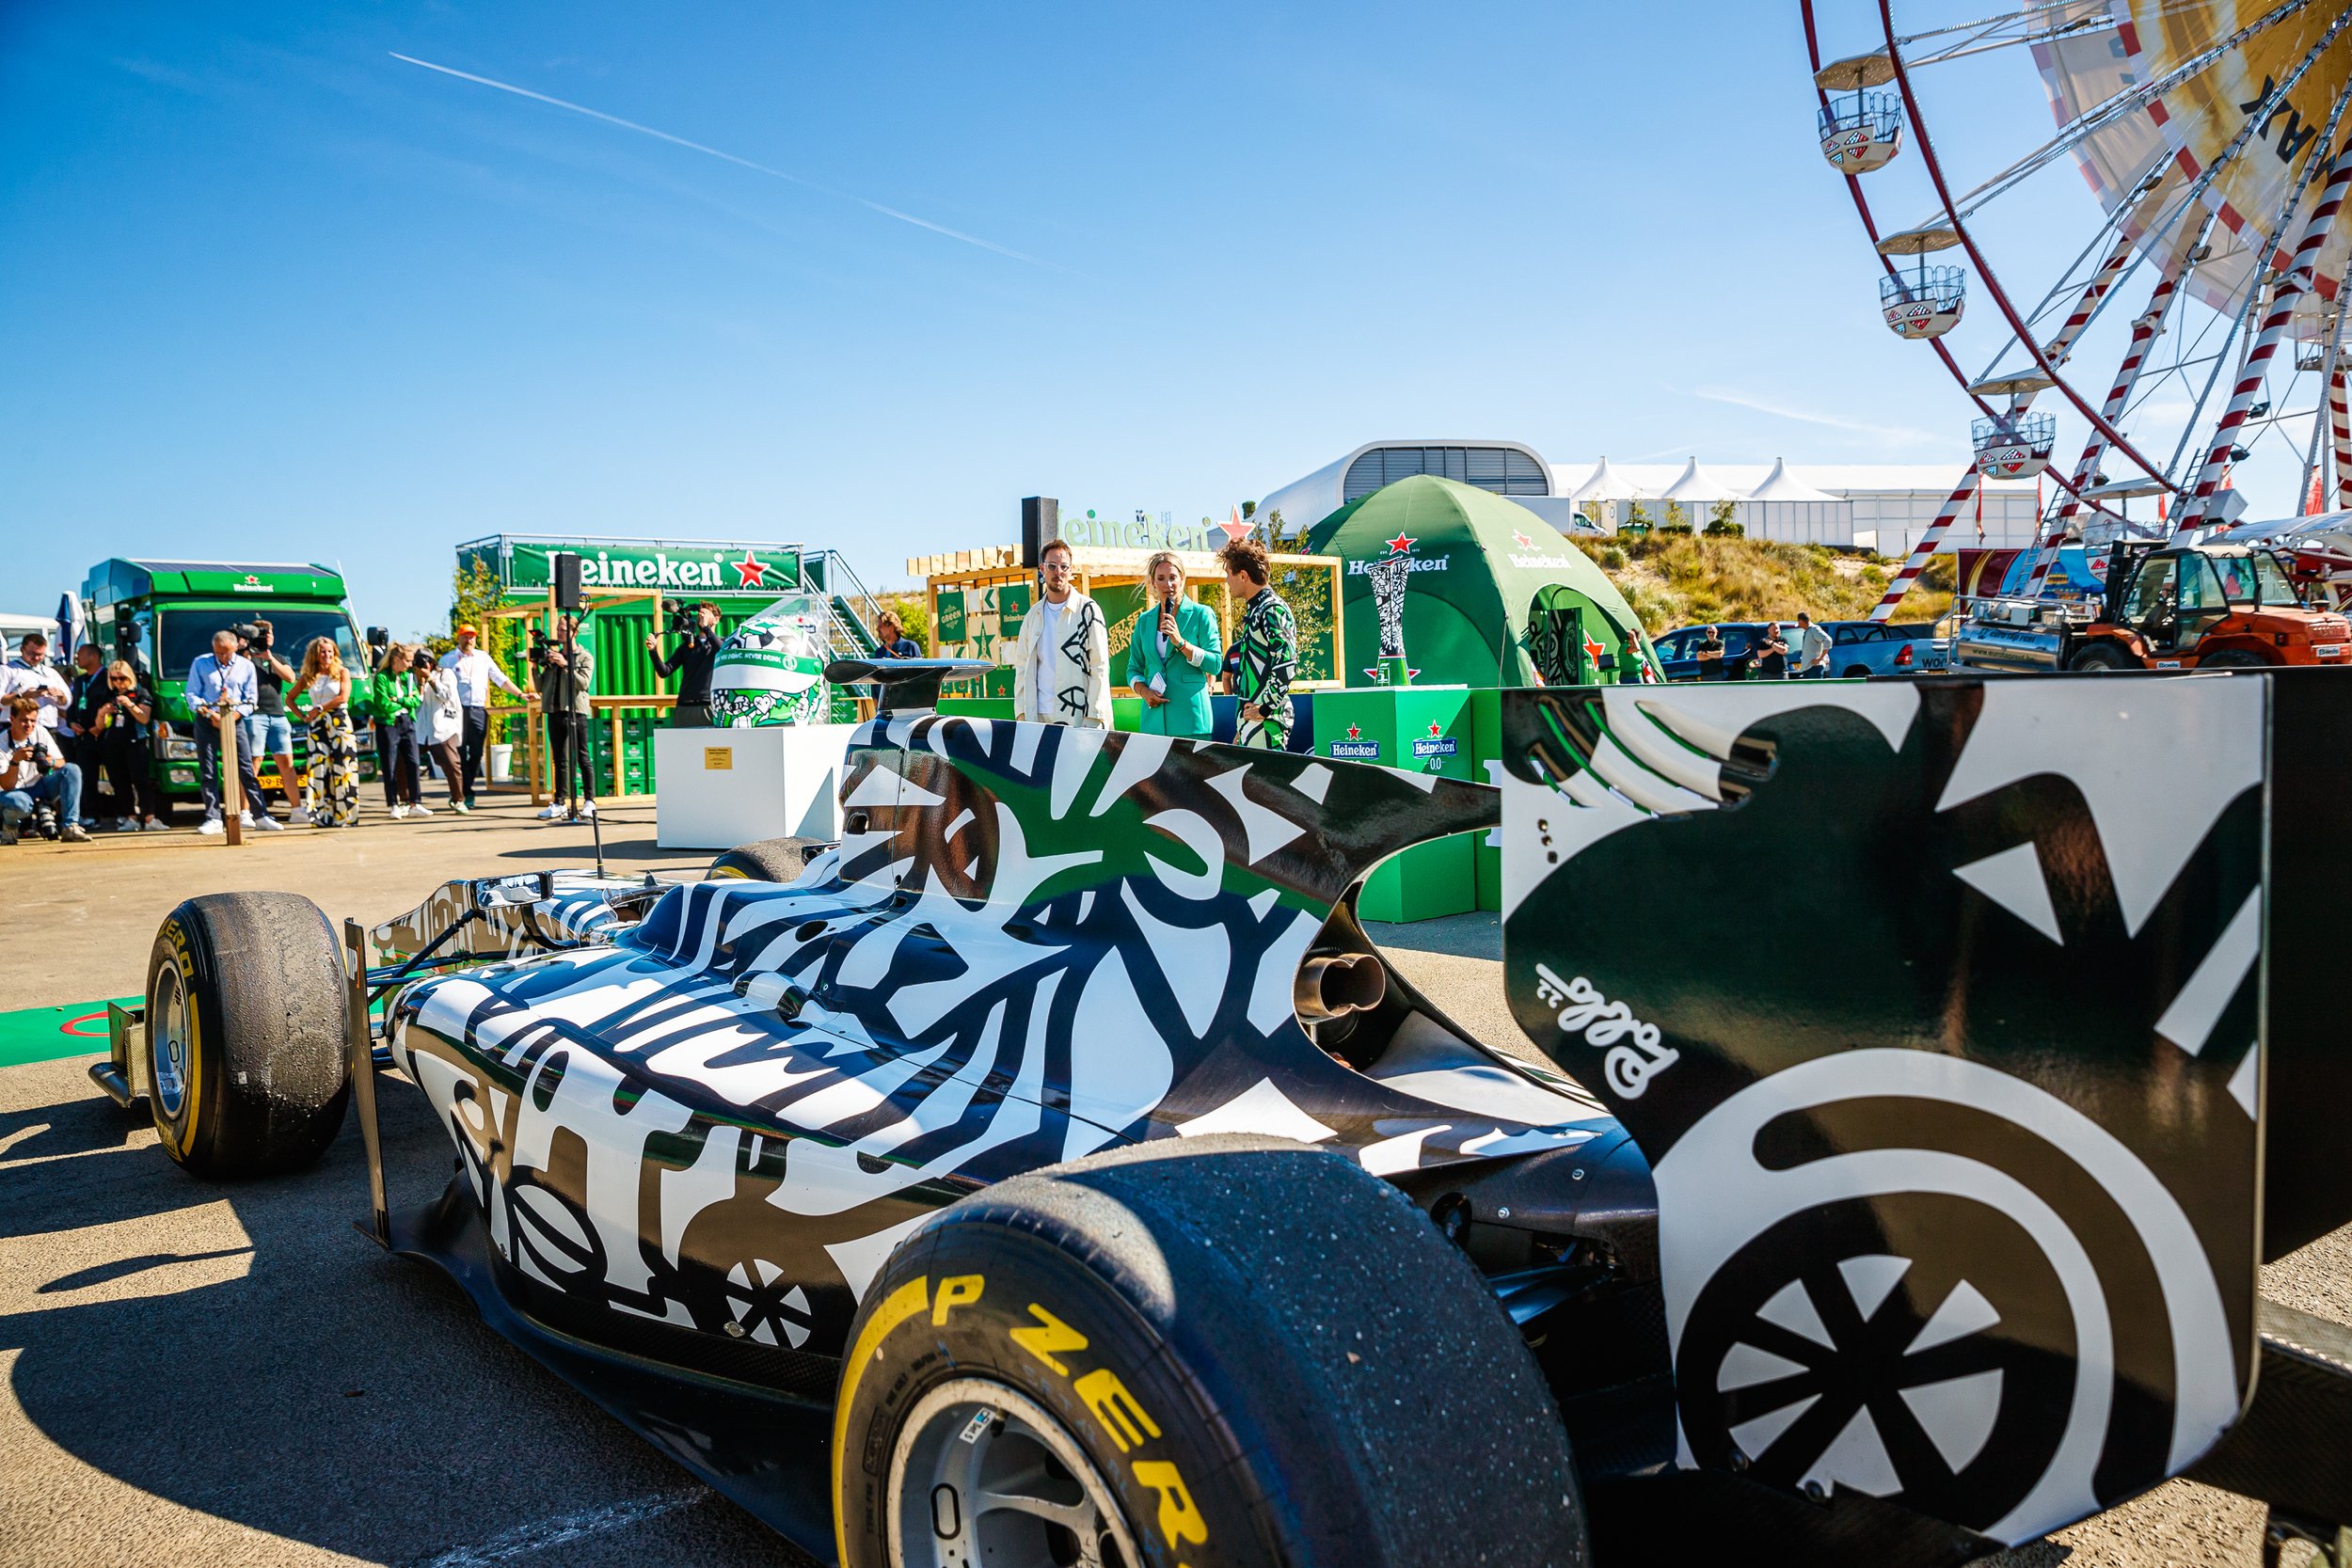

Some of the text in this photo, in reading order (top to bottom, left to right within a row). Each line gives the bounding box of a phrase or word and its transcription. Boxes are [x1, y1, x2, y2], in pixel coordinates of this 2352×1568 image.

[1507, 553, 1572, 569] Heineken
[1332, 744, 1377, 756] Heineken
[1415, 740, 1456, 755] Heineken
[1429, 757, 1441, 770] 0.0
[931, 1274, 984, 1326] P
[1009, 1303, 1208, 1568] ZER
